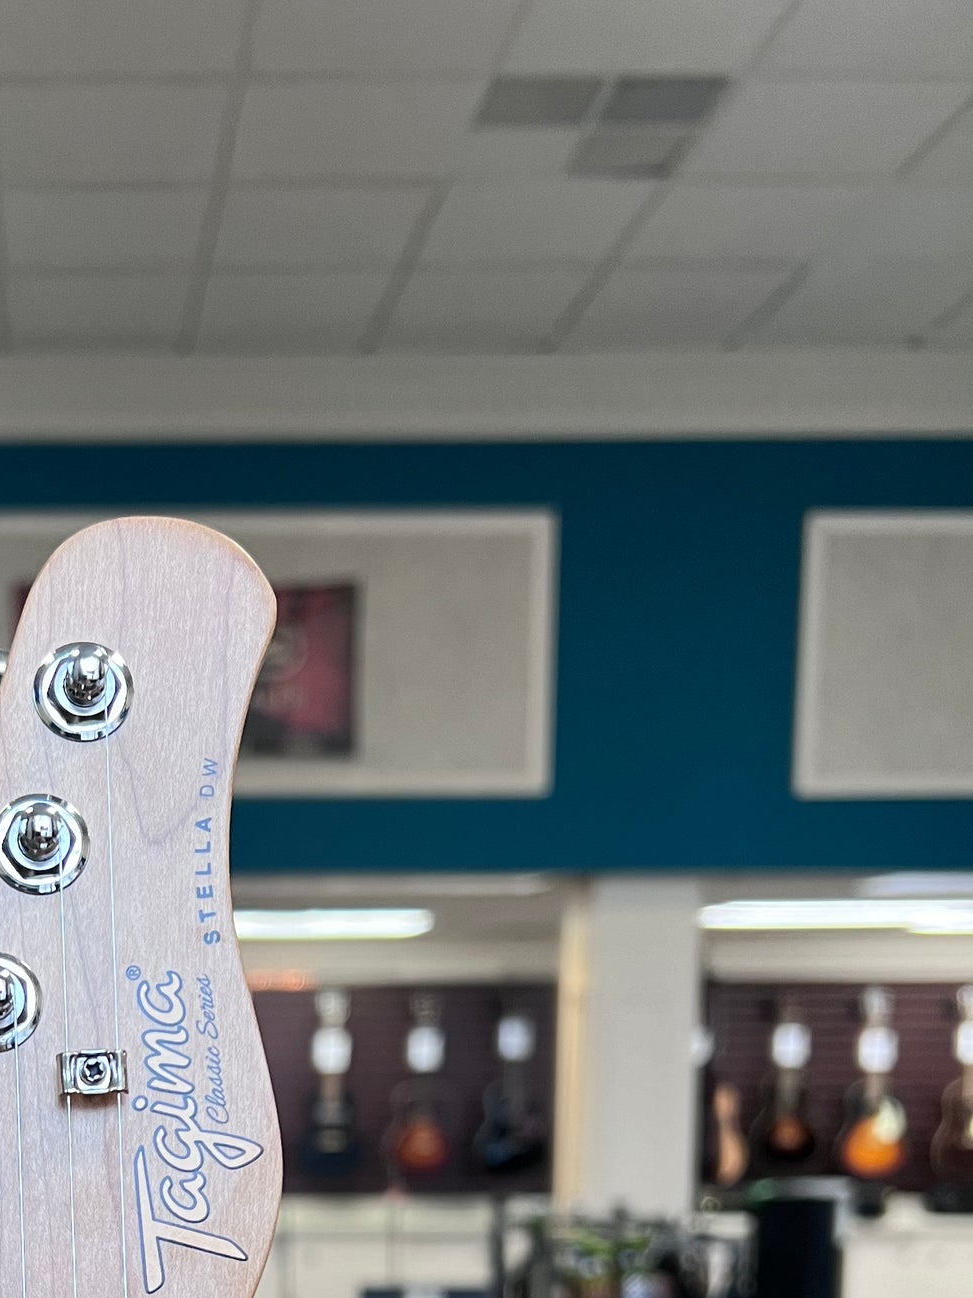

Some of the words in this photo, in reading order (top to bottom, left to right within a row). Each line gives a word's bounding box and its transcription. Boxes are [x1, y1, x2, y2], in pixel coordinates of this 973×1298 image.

[199, 757, 219, 798] DW
[195, 816, 221, 945] STELLA
[195, 973, 220, 1042] Series
[205, 1043, 230, 1125] Classic
[132, 968, 265, 1295] Tagima
